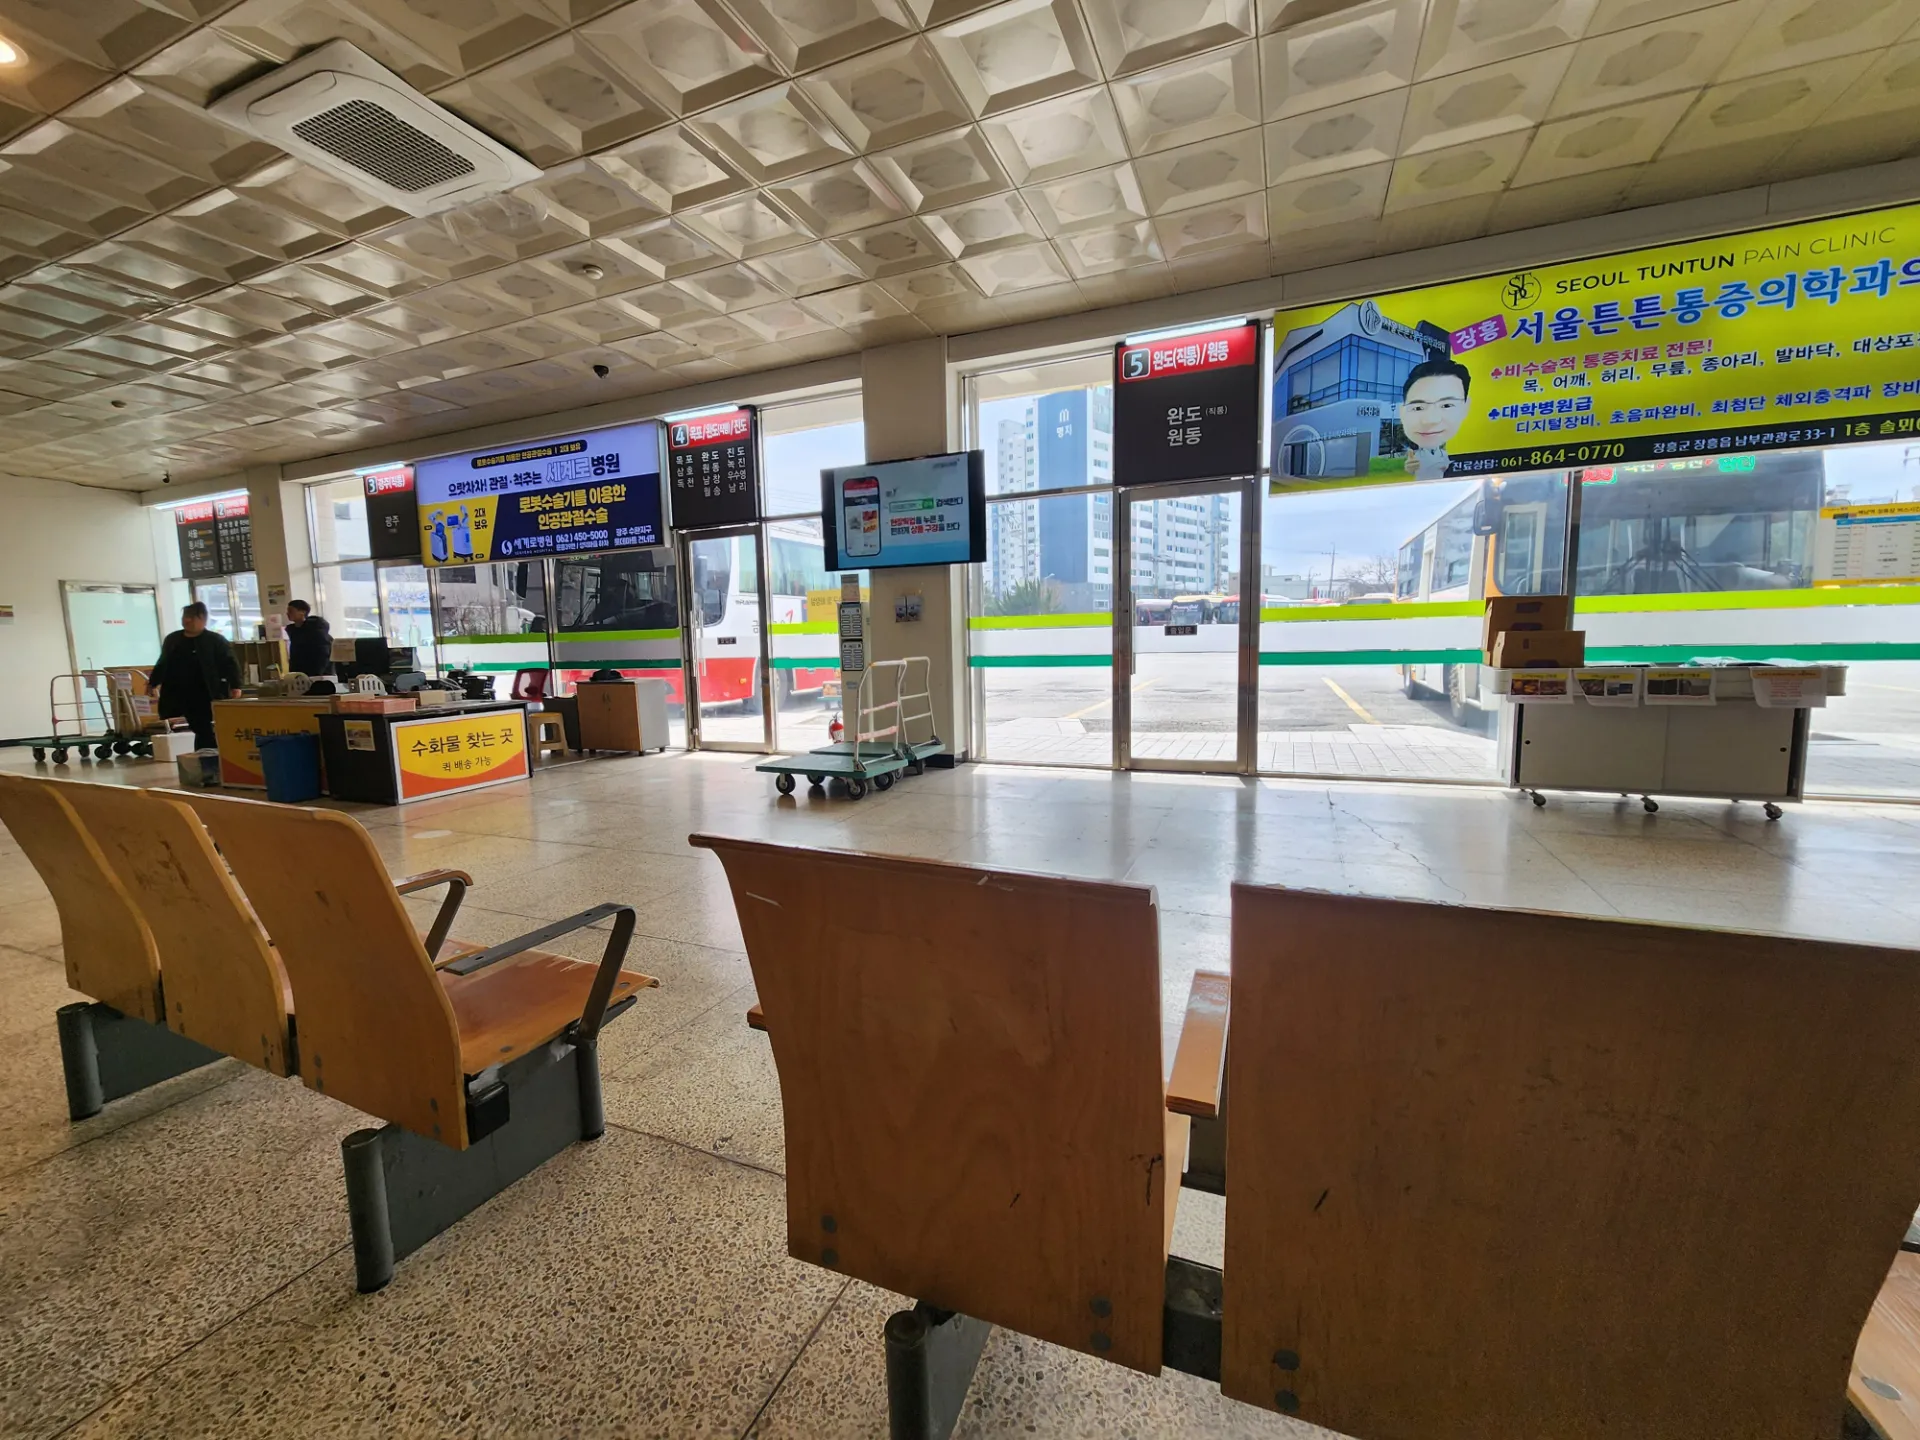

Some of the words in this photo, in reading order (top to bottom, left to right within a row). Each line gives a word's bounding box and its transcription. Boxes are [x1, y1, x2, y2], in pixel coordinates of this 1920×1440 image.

[1556, 270, 1630, 294] SEOUL
[1637, 253, 1735, 281] TUNTUN
[1744, 242, 1801, 265] PAIN
[1810, 227, 1896, 256] CLINIC
[1455, 320, 1501, 350] 장흥
[1130, 353, 1144, 377] 5
[1504, 356, 1576, 378] 비수술적
[1582, 347, 1660, 370] 통증치료
[1666, 339, 1713, 357] 전문!
[1523, 377, 1544, 393] 목,
[1553, 372, 1592, 390] 어깨,
[1601, 366, 1641, 384] 허리,
[1651, 360, 1692, 378] 무릎,
[1702, 351, 1764, 372] 종아리,
[1776, 341, 1841, 364] 발바닥,
[1167, 406, 1202, 425] 완도
[1501, 396, 1593, 420] 대학병원급
[1516, 411, 1600, 434] 디지털장비,
[1609, 403, 1701, 425] 초음파완비,
[1712, 395, 1766, 414] 최첨단
[1775, 385, 1872, 407] 체외충격파
[675, 427, 685, 443] 4
[1167, 427, 1202, 447] 원동
[1653, 440, 1690, 453] 장흥군
[1694, 436, 1731, 451] 장흥읍
[1735, 430, 1801, 446] 남부관광로
[1845, 422, 1871, 436] 1층
[1501, 443, 1625, 468] 061-864-0770
[368, 478, 376, 493] 3
[519, 489, 587, 513] 로봇수술기를
[589, 483, 627, 504] 이용한
[384, 515, 400, 527] 광주
[474, 508, 486, 518] 2대
[474, 519, 488, 530] 보유
[538, 506, 608, 530] 인공관절수술
[514, 535, 553, 550] 세계로병원
[616, 528, 628, 537] 광주
[411, 734, 461, 757] 수화물
[466, 732, 496, 751] 찾는
[500, 727, 514, 745] 곳
[442, 762, 452, 773] 퀵
[454, 758, 472, 770] 배송
[475, 755, 492, 767] 가능
